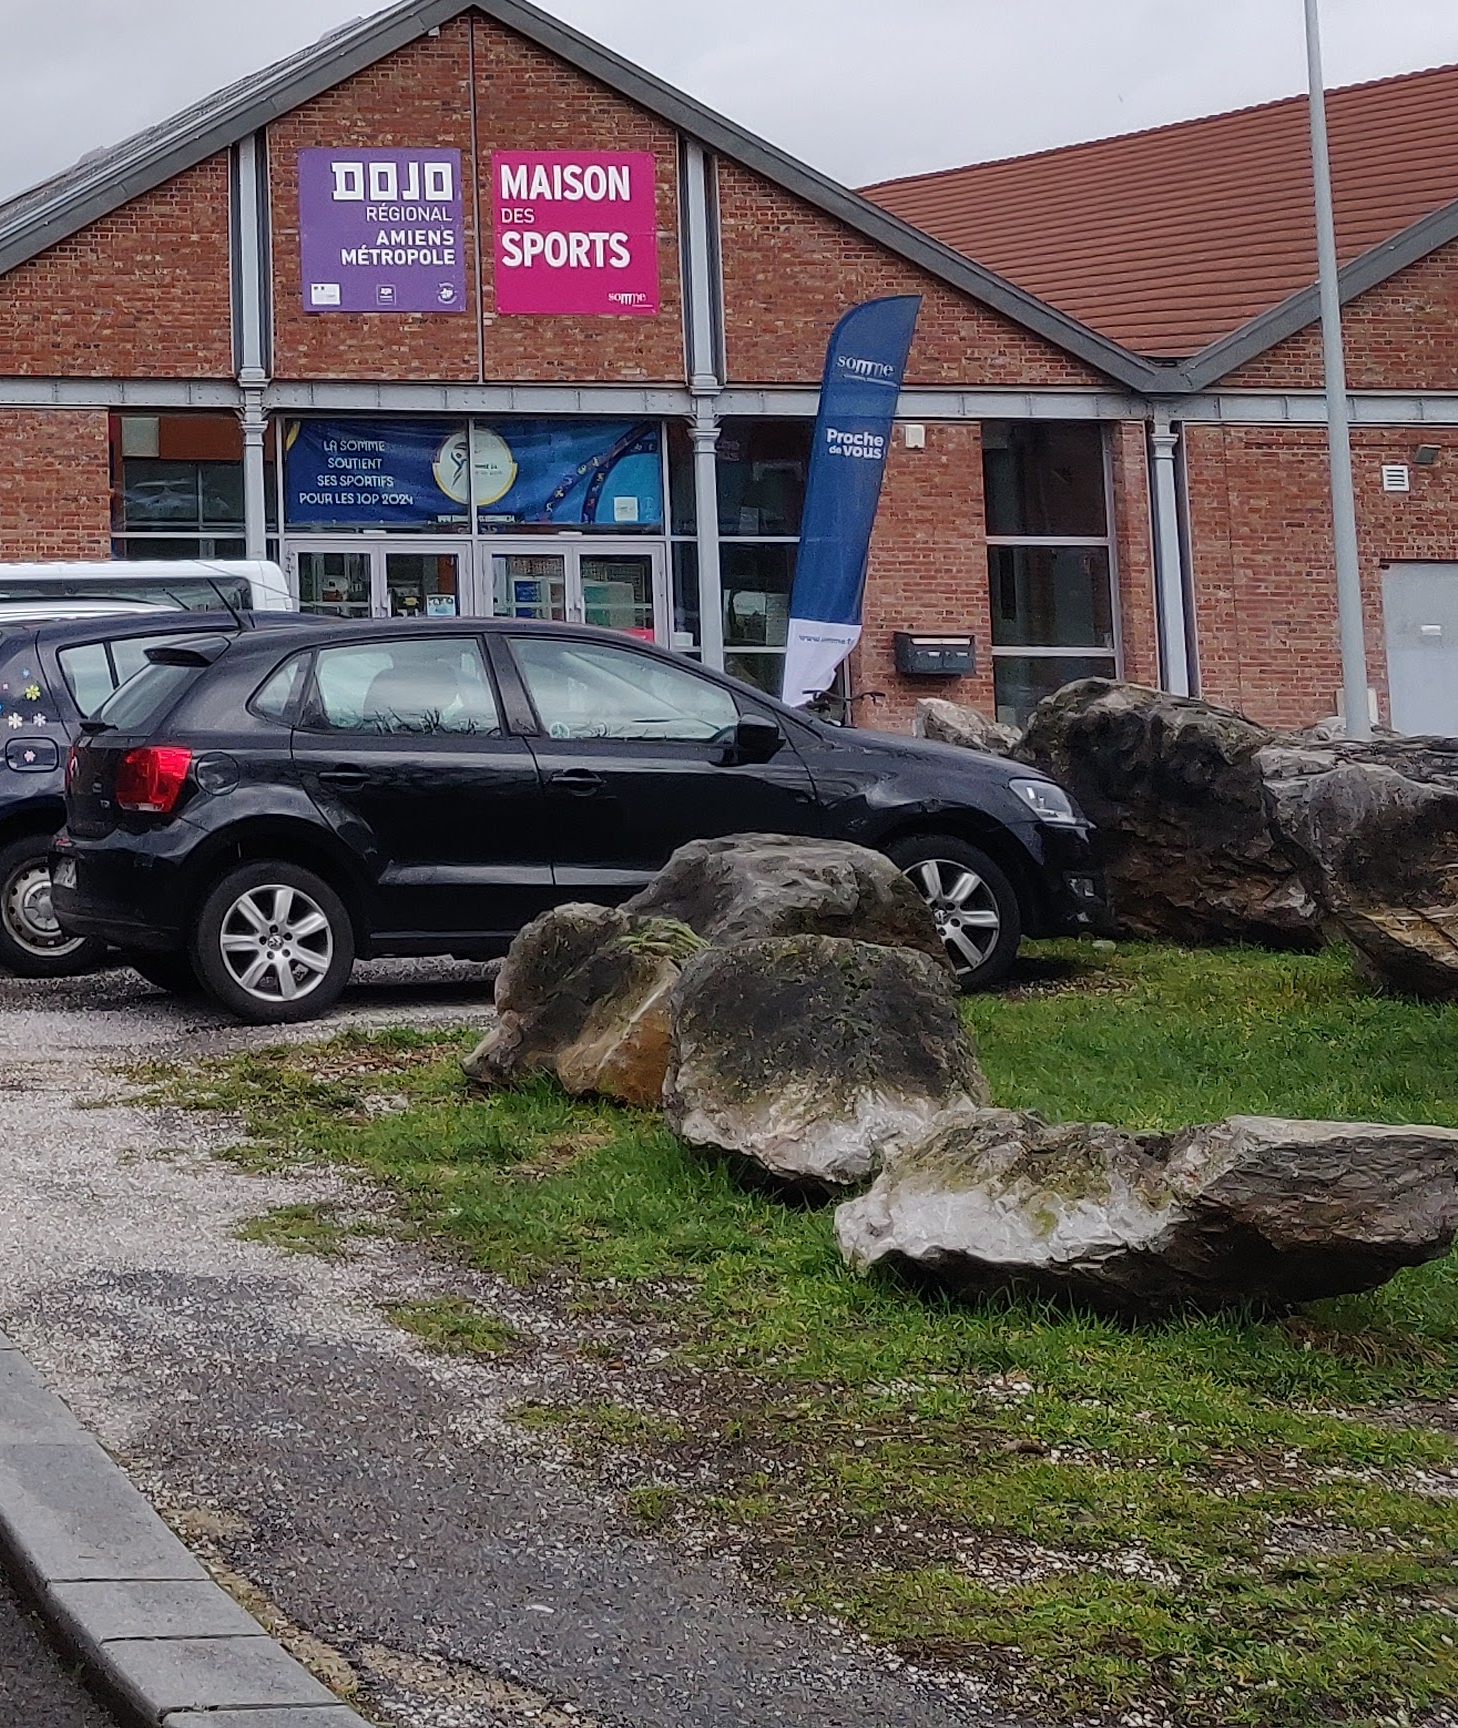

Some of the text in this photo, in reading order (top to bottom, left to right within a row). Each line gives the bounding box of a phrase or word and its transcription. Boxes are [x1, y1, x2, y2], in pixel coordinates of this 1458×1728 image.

[331, 161, 454, 202] DOJO
[500, 164, 631, 202] MAISON
[365, 202, 453, 222] RÉGIONAL
[501, 208, 535, 223] DES
[375, 229, 455, 246] AMIENS
[340, 245, 456, 266] MÉTROPOLE
[500, 230, 631, 269] SPORTS
[836, 355, 894, 377] somme
[323, 440, 386, 452] LA SOMME
[826, 427, 884, 447] Proche
[828, 445, 883, 460] de vous
[327, 457, 383, 470] SOUTIENT
[316, 475, 395, 488] SES SPORTIFS
[299, 492, 332, 505] POUR
[335, 492, 355, 505] LES
[382, 493, 414, 505] 2024
